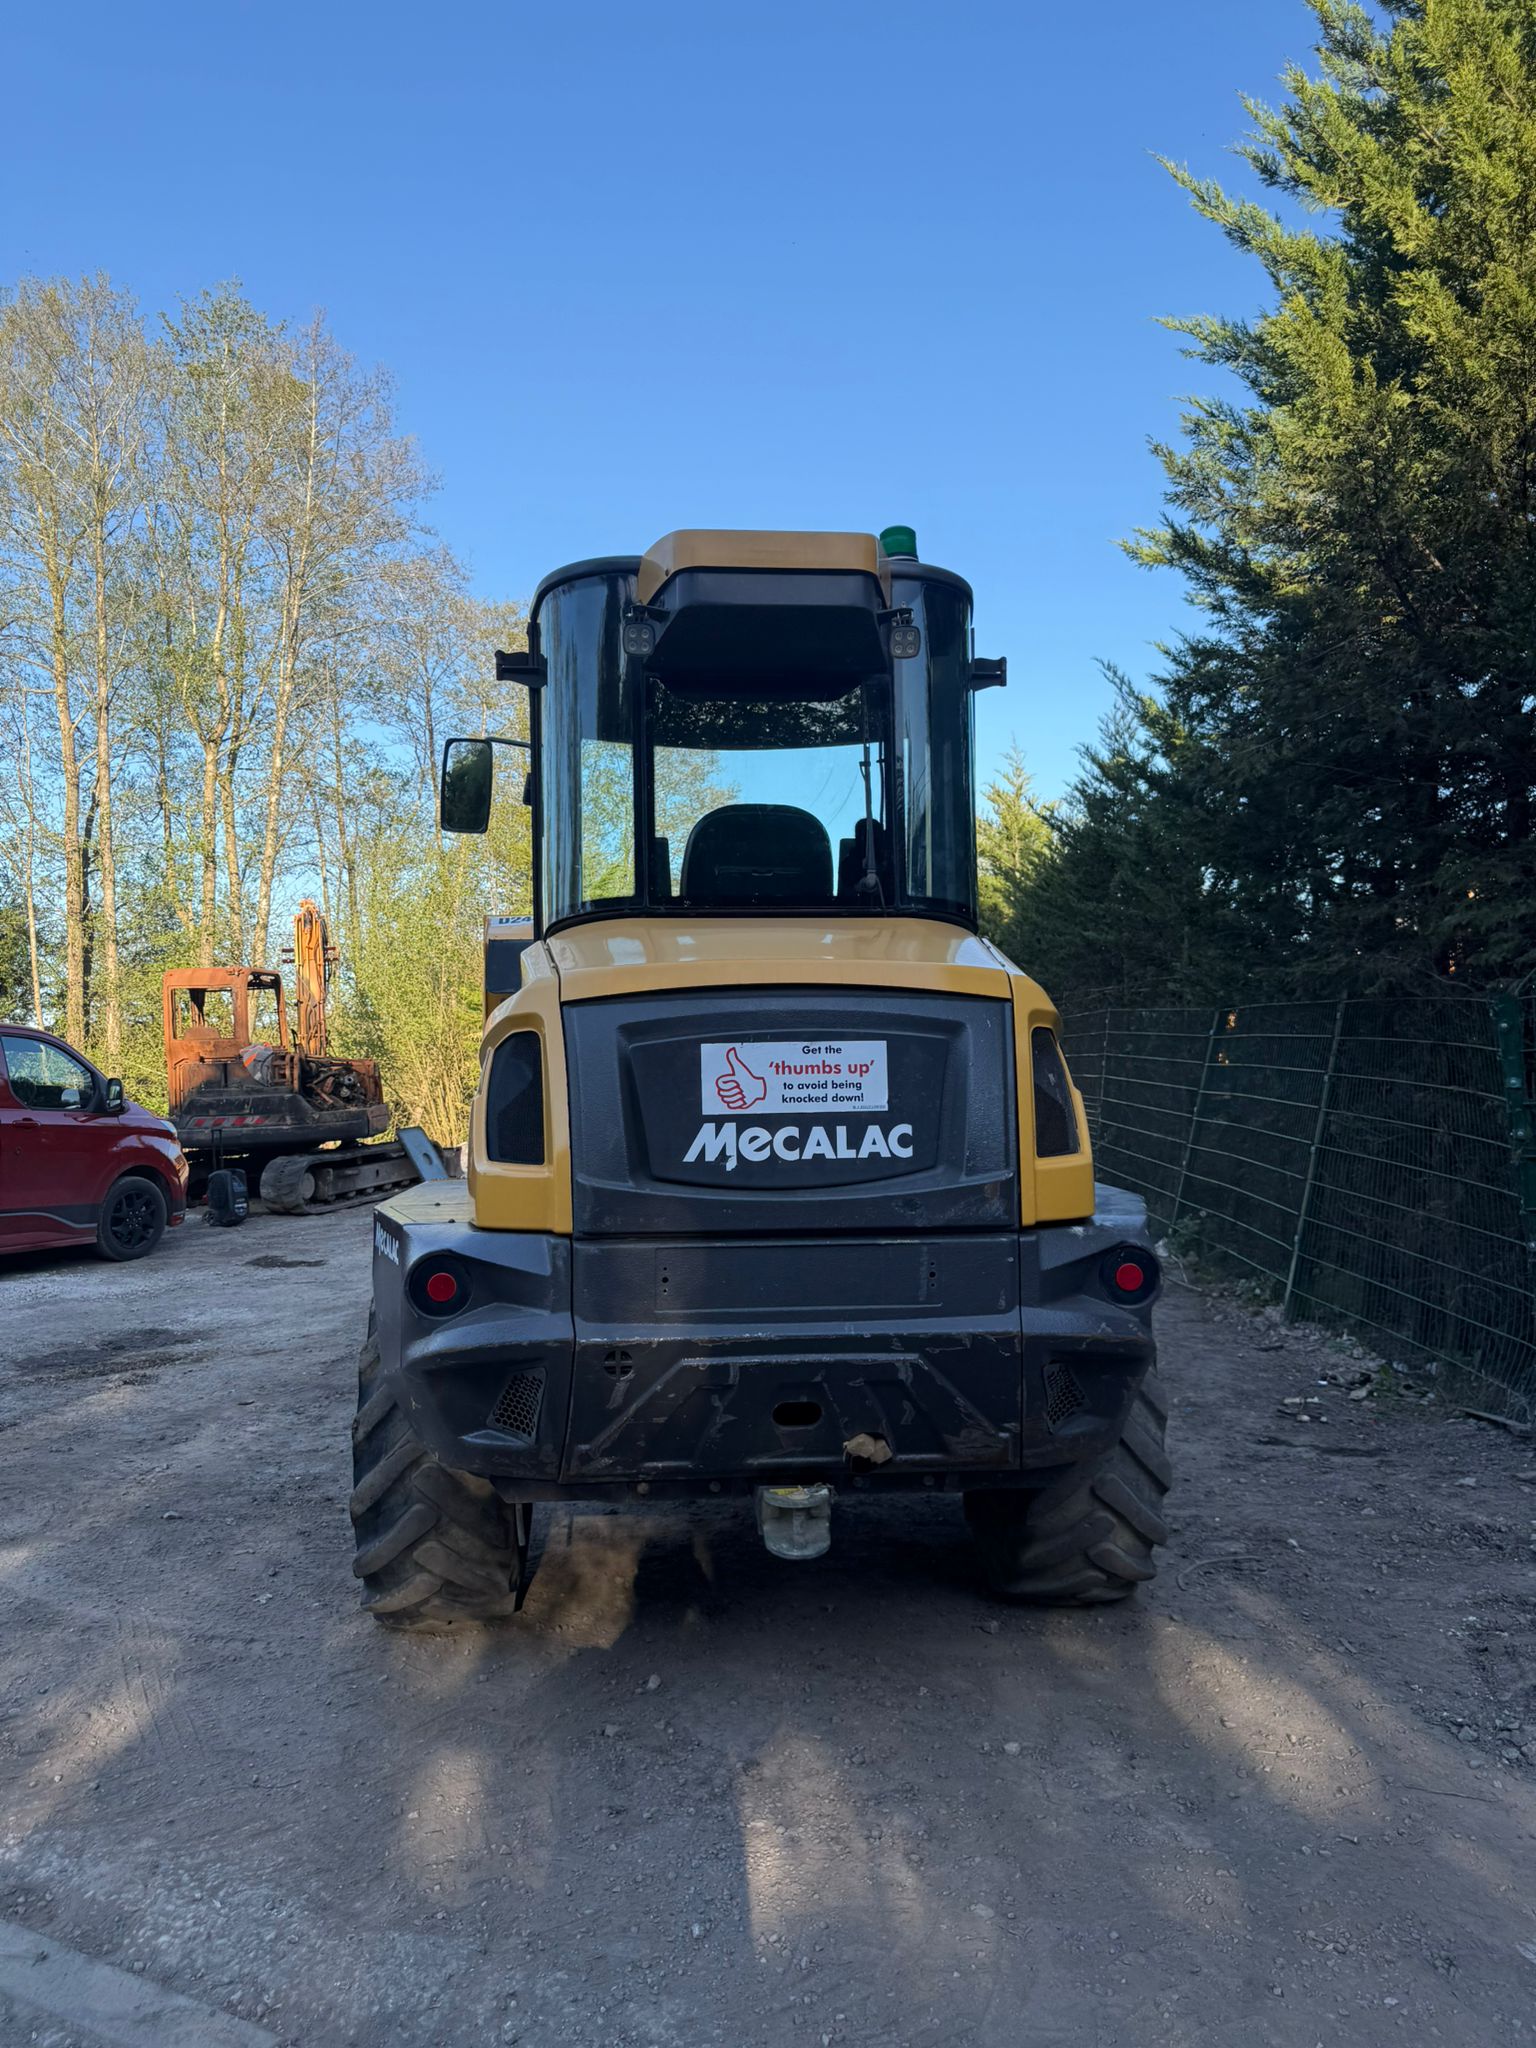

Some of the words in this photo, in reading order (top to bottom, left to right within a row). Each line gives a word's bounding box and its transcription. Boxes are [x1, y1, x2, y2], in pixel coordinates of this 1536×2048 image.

[802, 1045, 822, 1055] Get
[825, 1045, 842, 1054] the
[783, 1082, 794, 1090] to
[797, 1081, 828, 1090] avoid
[832, 1080, 862, 1091] being
[782, 1093, 828, 1103] knocked
[832, 1093, 864, 1102] down!
